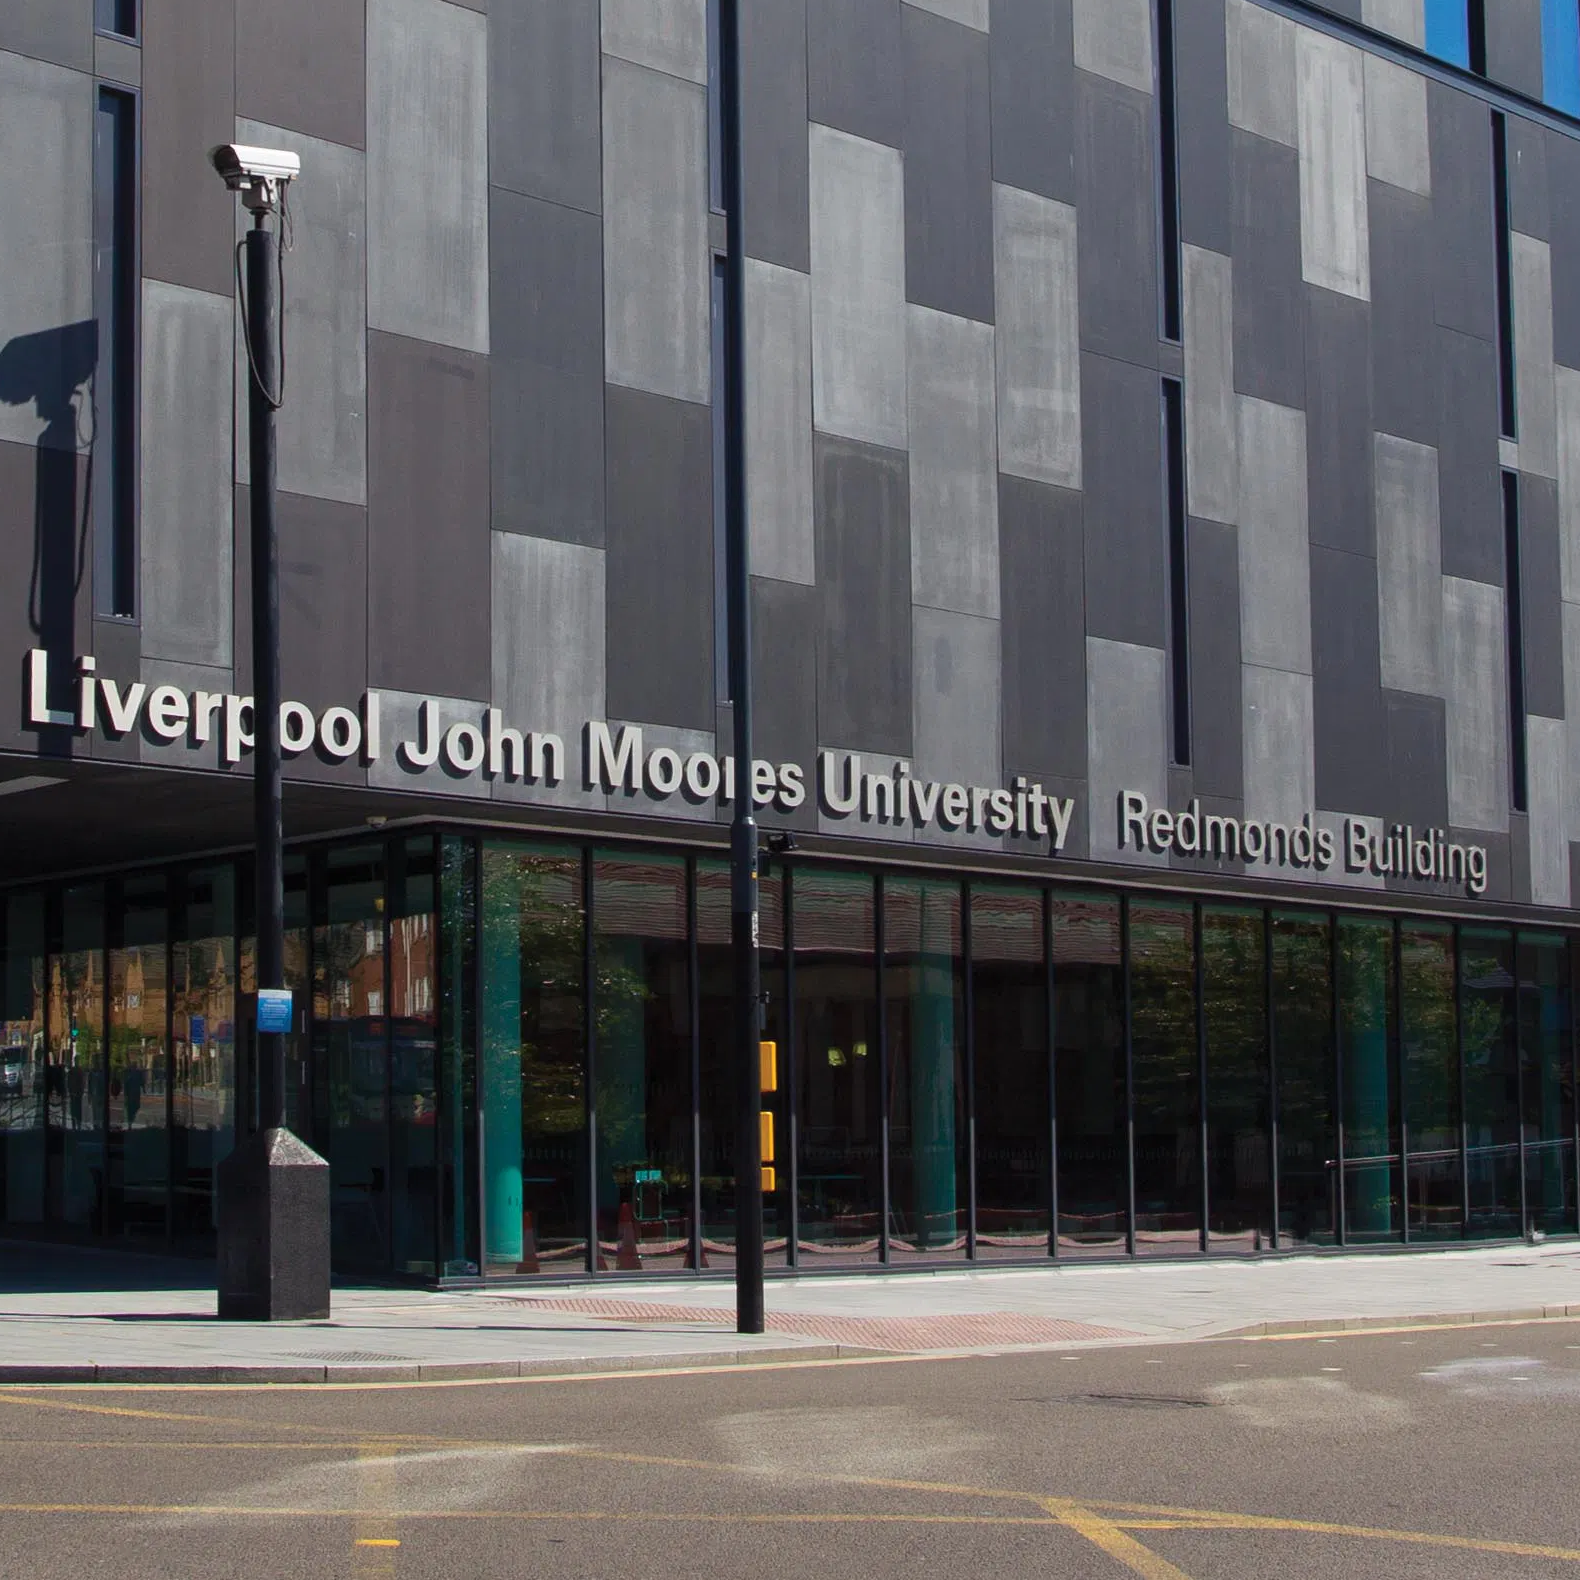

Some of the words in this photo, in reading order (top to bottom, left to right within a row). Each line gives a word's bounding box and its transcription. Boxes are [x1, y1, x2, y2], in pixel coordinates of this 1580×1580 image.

[29, 648, 381, 763] Liverpool
[402, 699, 565, 781] John
[822, 751, 1075, 849] University
[1122, 790, 1336, 868] Redmonds
[1349, 816, 1488, 893] Building
